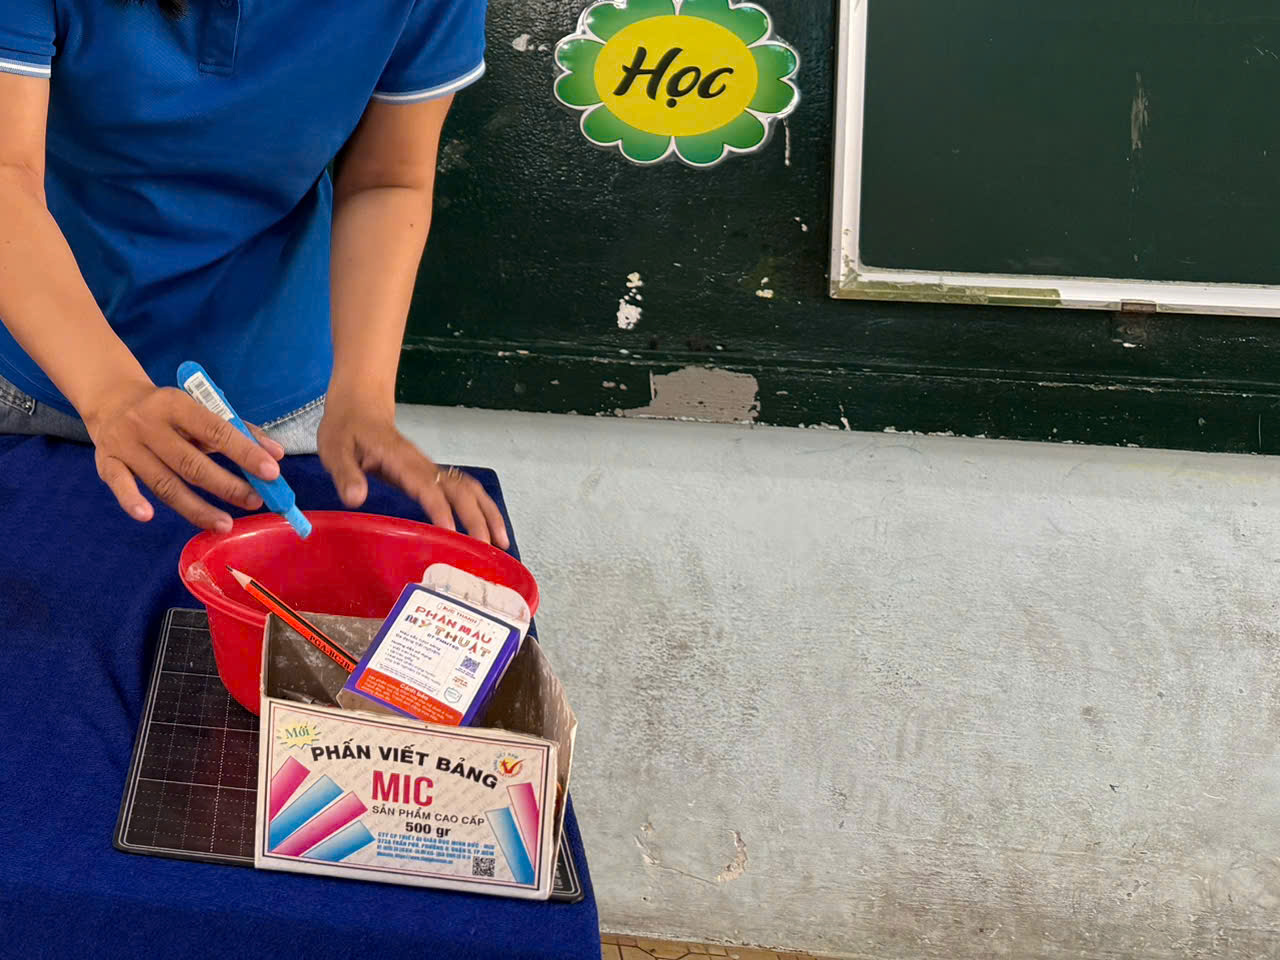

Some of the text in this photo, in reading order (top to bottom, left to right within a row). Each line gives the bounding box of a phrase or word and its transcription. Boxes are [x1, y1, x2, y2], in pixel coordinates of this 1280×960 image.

[613, 46, 734, 108] Học
[285, 724, 310, 739] Mới
[311, 738, 371, 761] PHẤN
[379, 744, 429, 766] VIẾT
[436, 757, 498, 790] BẢNG
[372, 770, 433, 807] MIC
[372, 804, 485, 826] SẢN PHẨM CAO CẤP
[405, 821, 451, 838] 500 gr
